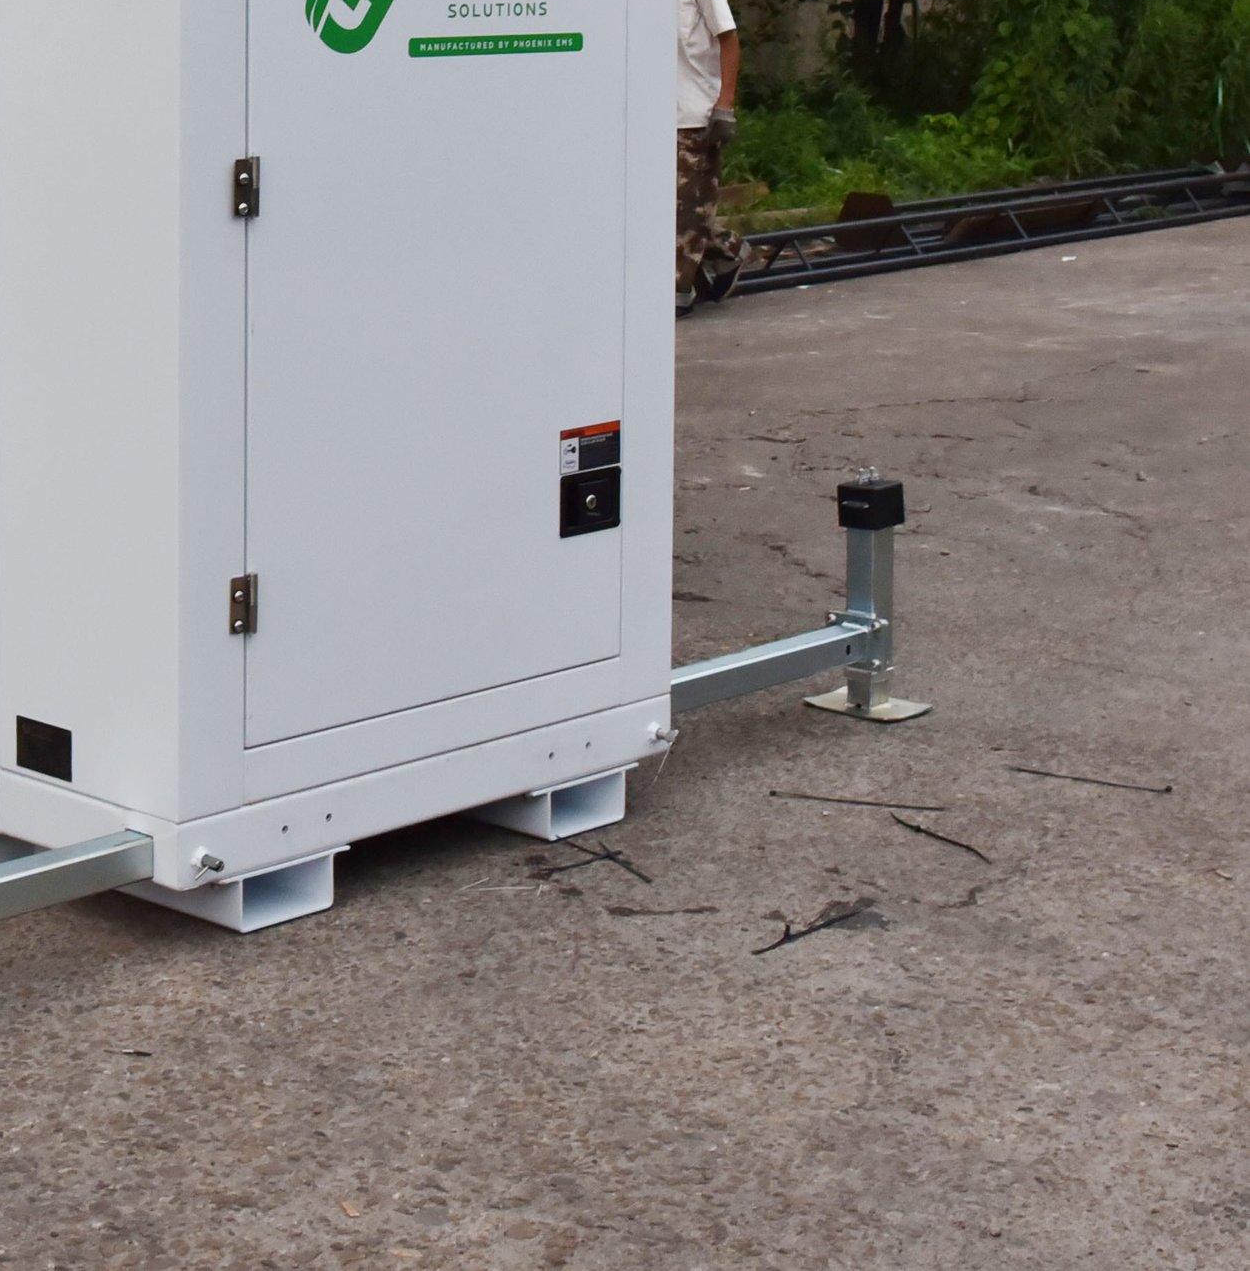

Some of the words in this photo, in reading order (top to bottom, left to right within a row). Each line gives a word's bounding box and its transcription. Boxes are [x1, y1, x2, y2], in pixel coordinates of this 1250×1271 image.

[447, 1, 548, 19] SOLUTIONS
[419, 40, 494, 52] MANUFACTURED
[498, 39, 510, 50] BY
[513, 39, 553, 48] PHOENIX
[556, 38, 573, 47] EMS
